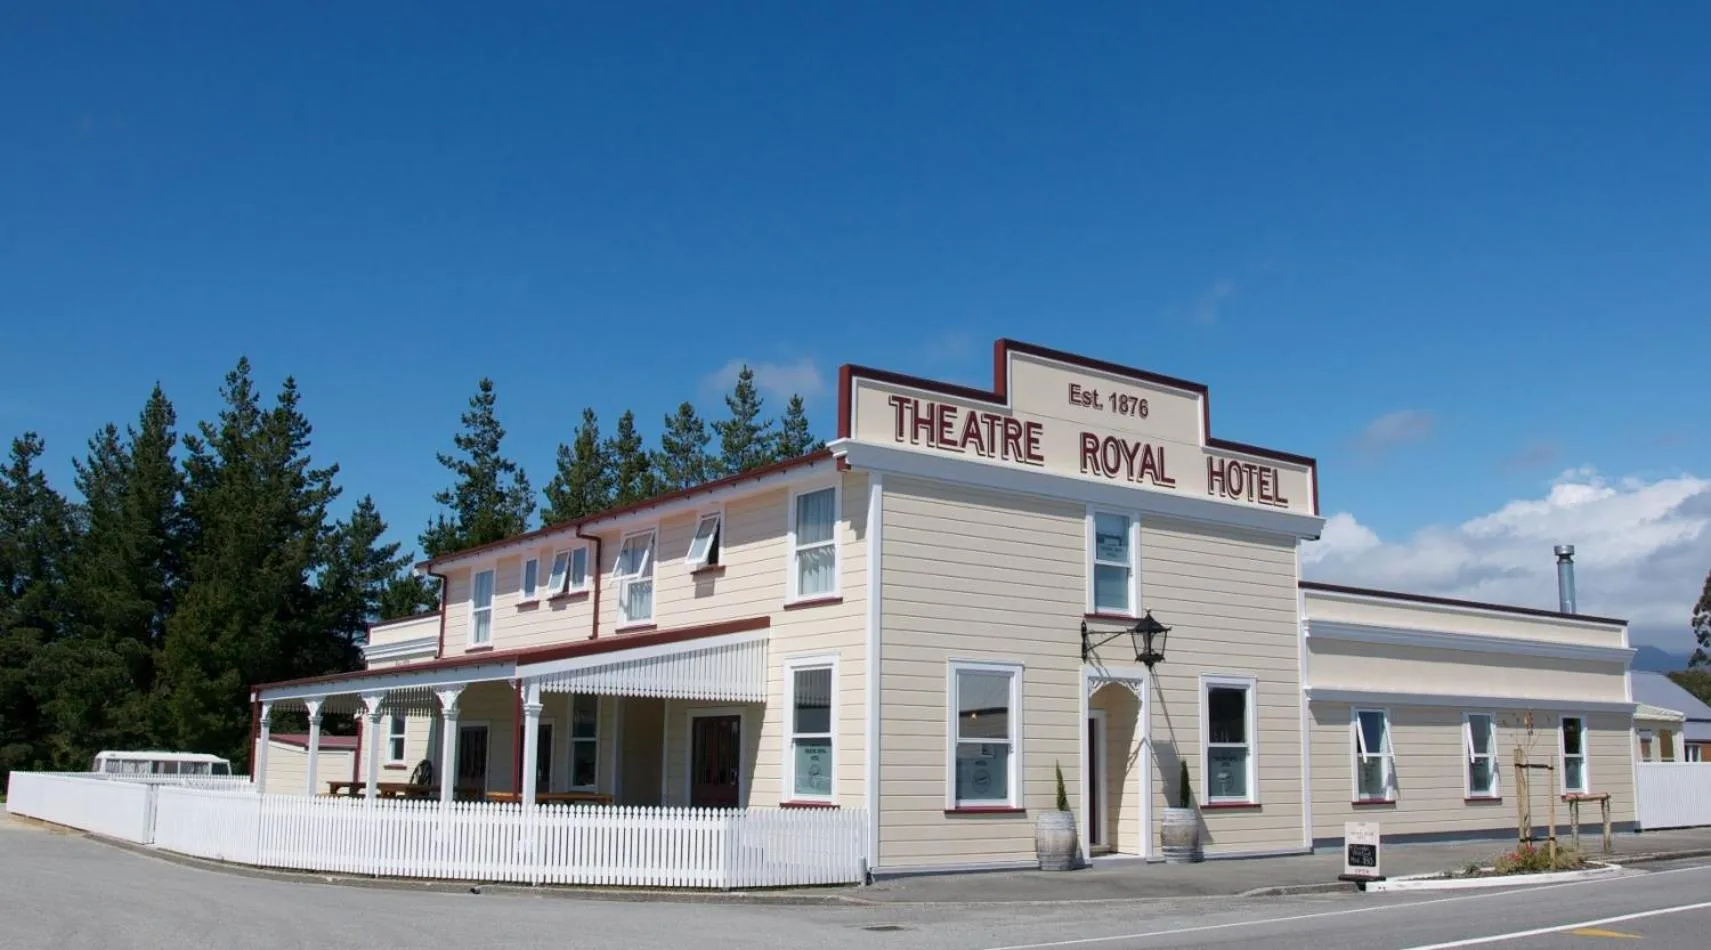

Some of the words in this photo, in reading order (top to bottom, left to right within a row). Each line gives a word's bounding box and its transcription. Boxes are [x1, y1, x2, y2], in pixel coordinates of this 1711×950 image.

[1068, 383, 1103, 411] Est.
[1108, 392, 1149, 418] 1876
[889, 395, 1044, 466] THEATRE
[1080, 432, 1176, 488] ROYAL
[1207, 456, 1288, 508] HOTEL
